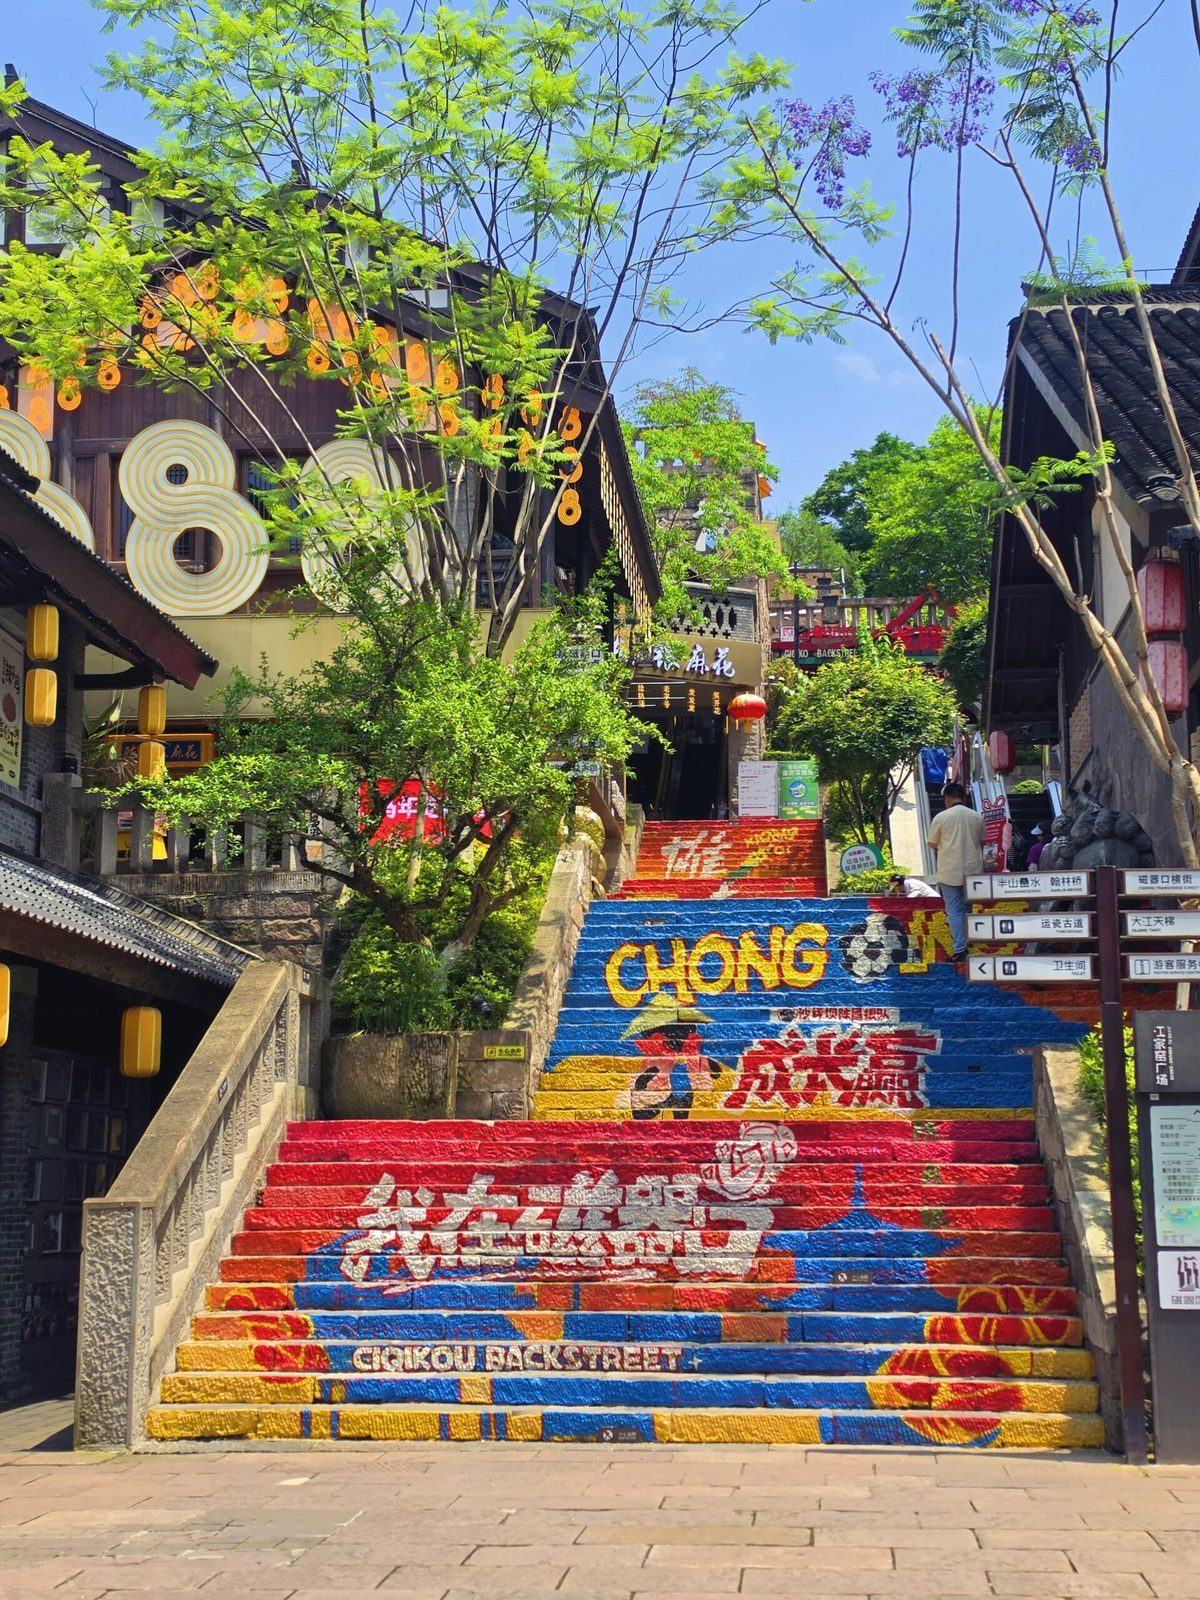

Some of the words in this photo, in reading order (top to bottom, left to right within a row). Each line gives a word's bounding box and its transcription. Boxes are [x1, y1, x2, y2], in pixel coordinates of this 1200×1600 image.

[997, 877, 1040, 888] 半山叠水
[1050, 876, 1082, 887] 翰林桥
[1138, 874, 1192, 885] 磁器口横街
[1041, 918, 1084, 928] 运瓷古道
[1131, 915, 1176, 927] 大江天梯
[605, 922, 830, 1008] CHONG
[1052, 960, 1086, 971] 卫生间
[1153, 959, 1200, 970] 游客服务
[798, 1006, 889, 1020] 沙坪坝陈昌银队
[340, 1171, 776, 1284] 我在磁器口
[352, 1344, 476, 1371] CIQIKOU
[485, 1344, 682, 1371] BACKSTREET
